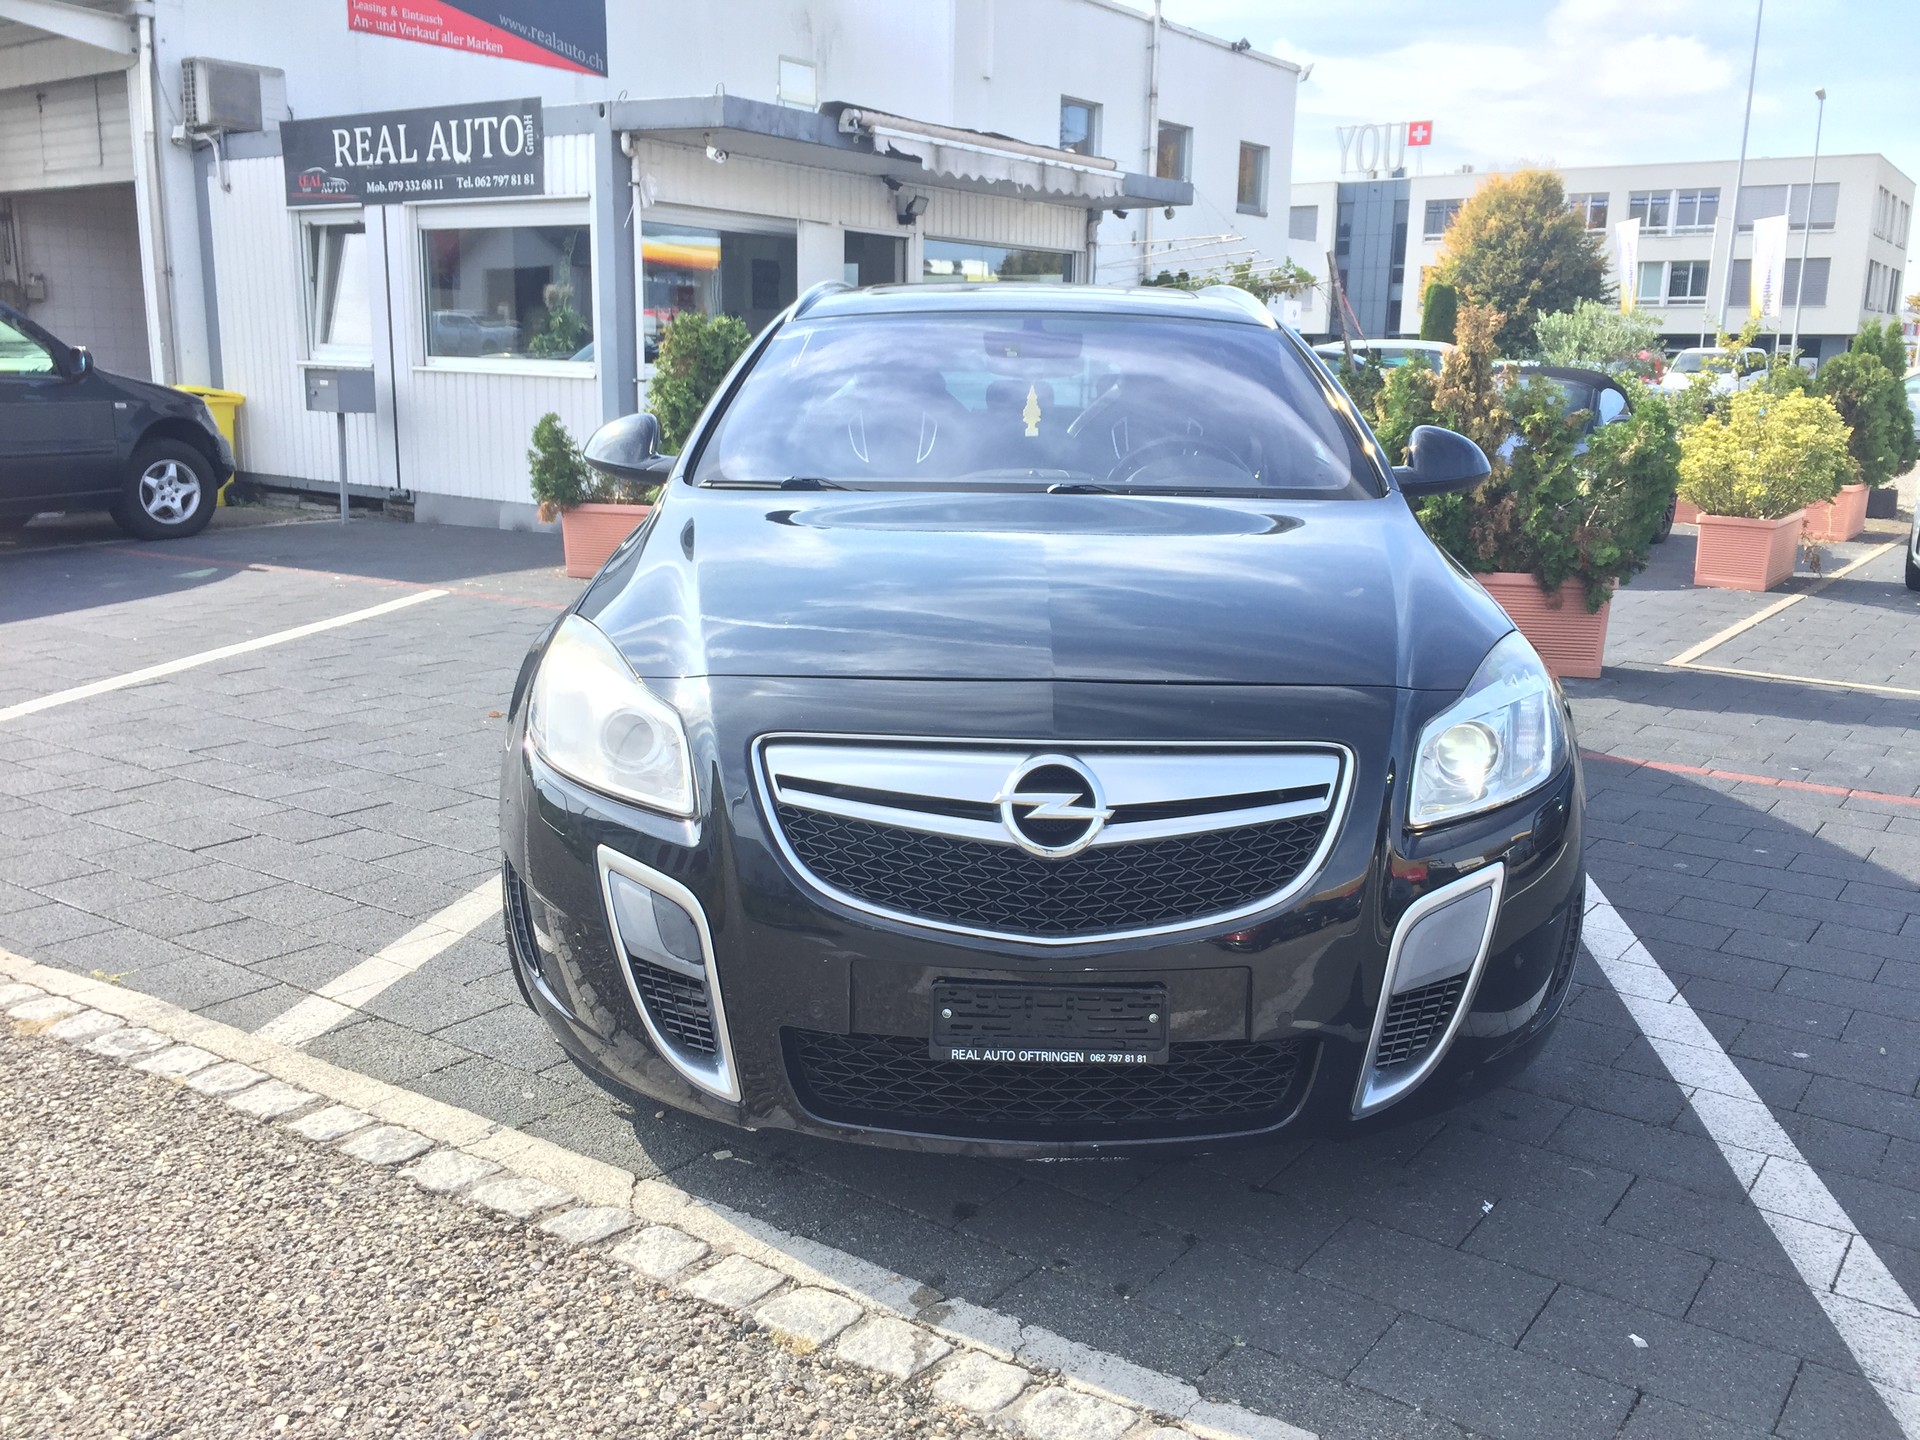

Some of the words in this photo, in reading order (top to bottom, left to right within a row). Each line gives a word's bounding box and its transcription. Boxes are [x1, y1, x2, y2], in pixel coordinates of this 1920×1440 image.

[353, 0, 387, 17] Leasing
[390, 5, 398, 17] &
[401, 7, 443, 26] Eintausch
[353, 14, 374, 28] An-
[376, 20, 397, 33] und
[399, 21, 441, 41] Verkauf
[441, 31, 465, 46] aller
[466, 34, 503, 54] Marken
[499, 14, 604, 71] www.realauto.ch
[332, 124, 418, 168] REAL
[427, 114, 524, 164] AUTO
[523, 114, 533, 156] GmbH
[1335, 121, 1407, 175] YOU
[321, 181, 347, 194] AUTO
[366, 181, 388, 194] Mob.
[388, 180, 404, 193] 079
[404, 179, 421, 192] 332
[421, 179, 432, 191] 68
[433, 178, 444, 190] 11
[456, 176, 473, 189] Tel.
[475, 175, 492, 188] 062
[492, 174, 509, 187] 797
[510, 174, 521, 186] 81
[523, 173, 535, 185] 81
[951, 1049, 980, 1060] REAL
[983, 1049, 1016, 1061] AUTO
[1018, 1050, 1084, 1062] OFTRINGEN
[1090, 1053, 1105, 1063] 062
[1107, 1054, 1123, 1063] 797
[1124, 1054, 1134, 1063] 81
[1136, 1054, 1147, 1063] 81
